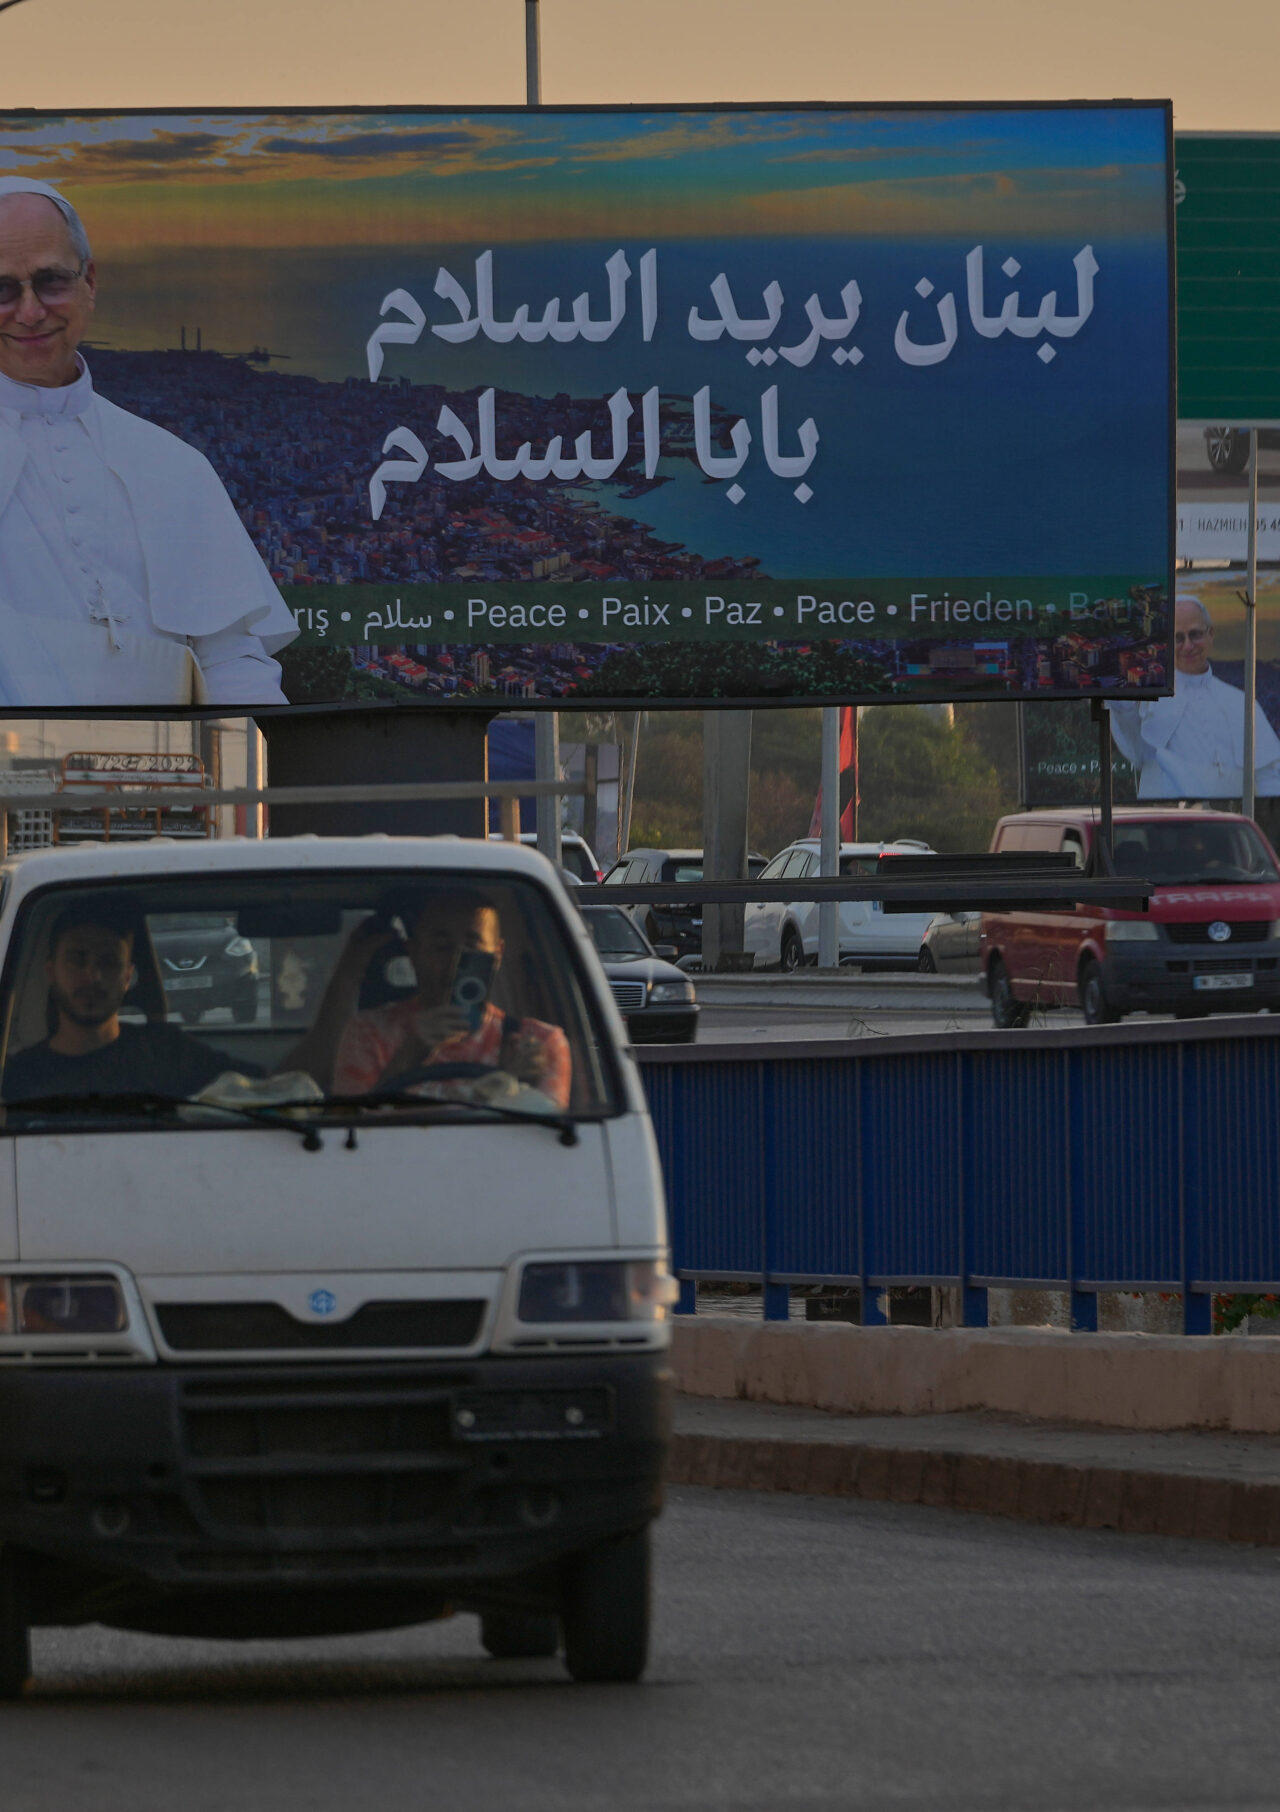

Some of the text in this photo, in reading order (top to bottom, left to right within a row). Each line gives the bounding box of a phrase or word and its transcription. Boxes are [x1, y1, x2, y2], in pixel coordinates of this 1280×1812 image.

[367, 244, 1100, 383] لبنان يريد السلام
[369, 384, 820, 521] بابا السلام
[293, 607, 329, 636] rış
[364, 599, 432, 640] سلام
[468, 599, 566, 627] Peace
[602, 596, 671, 626] Paix
[705, 596, 762, 625] Paz
[797, 595, 875, 623] Pace
[910, 592, 1033, 622] Frieden
[1038, 761, 1077, 775] Peace
